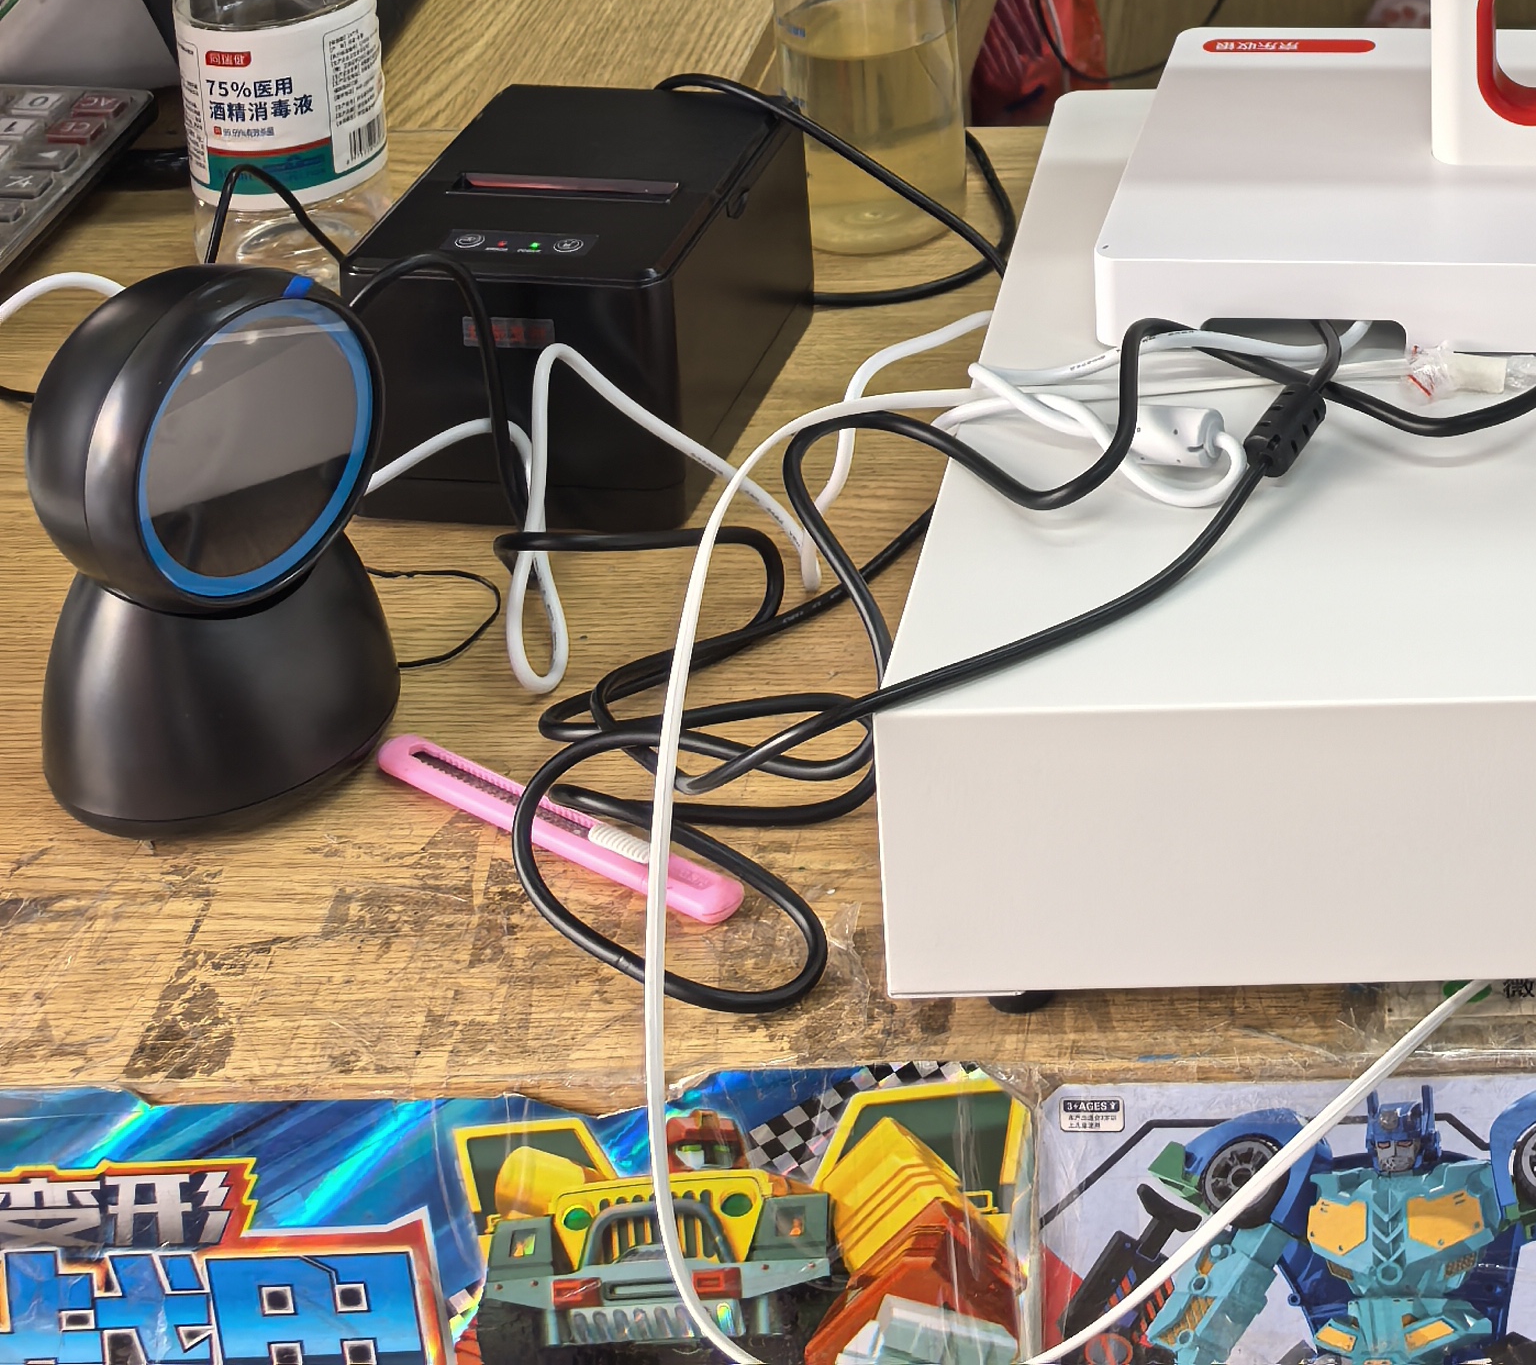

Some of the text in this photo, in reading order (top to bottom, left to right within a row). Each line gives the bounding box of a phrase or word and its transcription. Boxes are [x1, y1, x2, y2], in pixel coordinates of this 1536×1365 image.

[206, 76, 294, 99] 75%医用
[208, 94, 315, 123] 酒精消毒液
[0, 1170, 231, 1248] 变形
